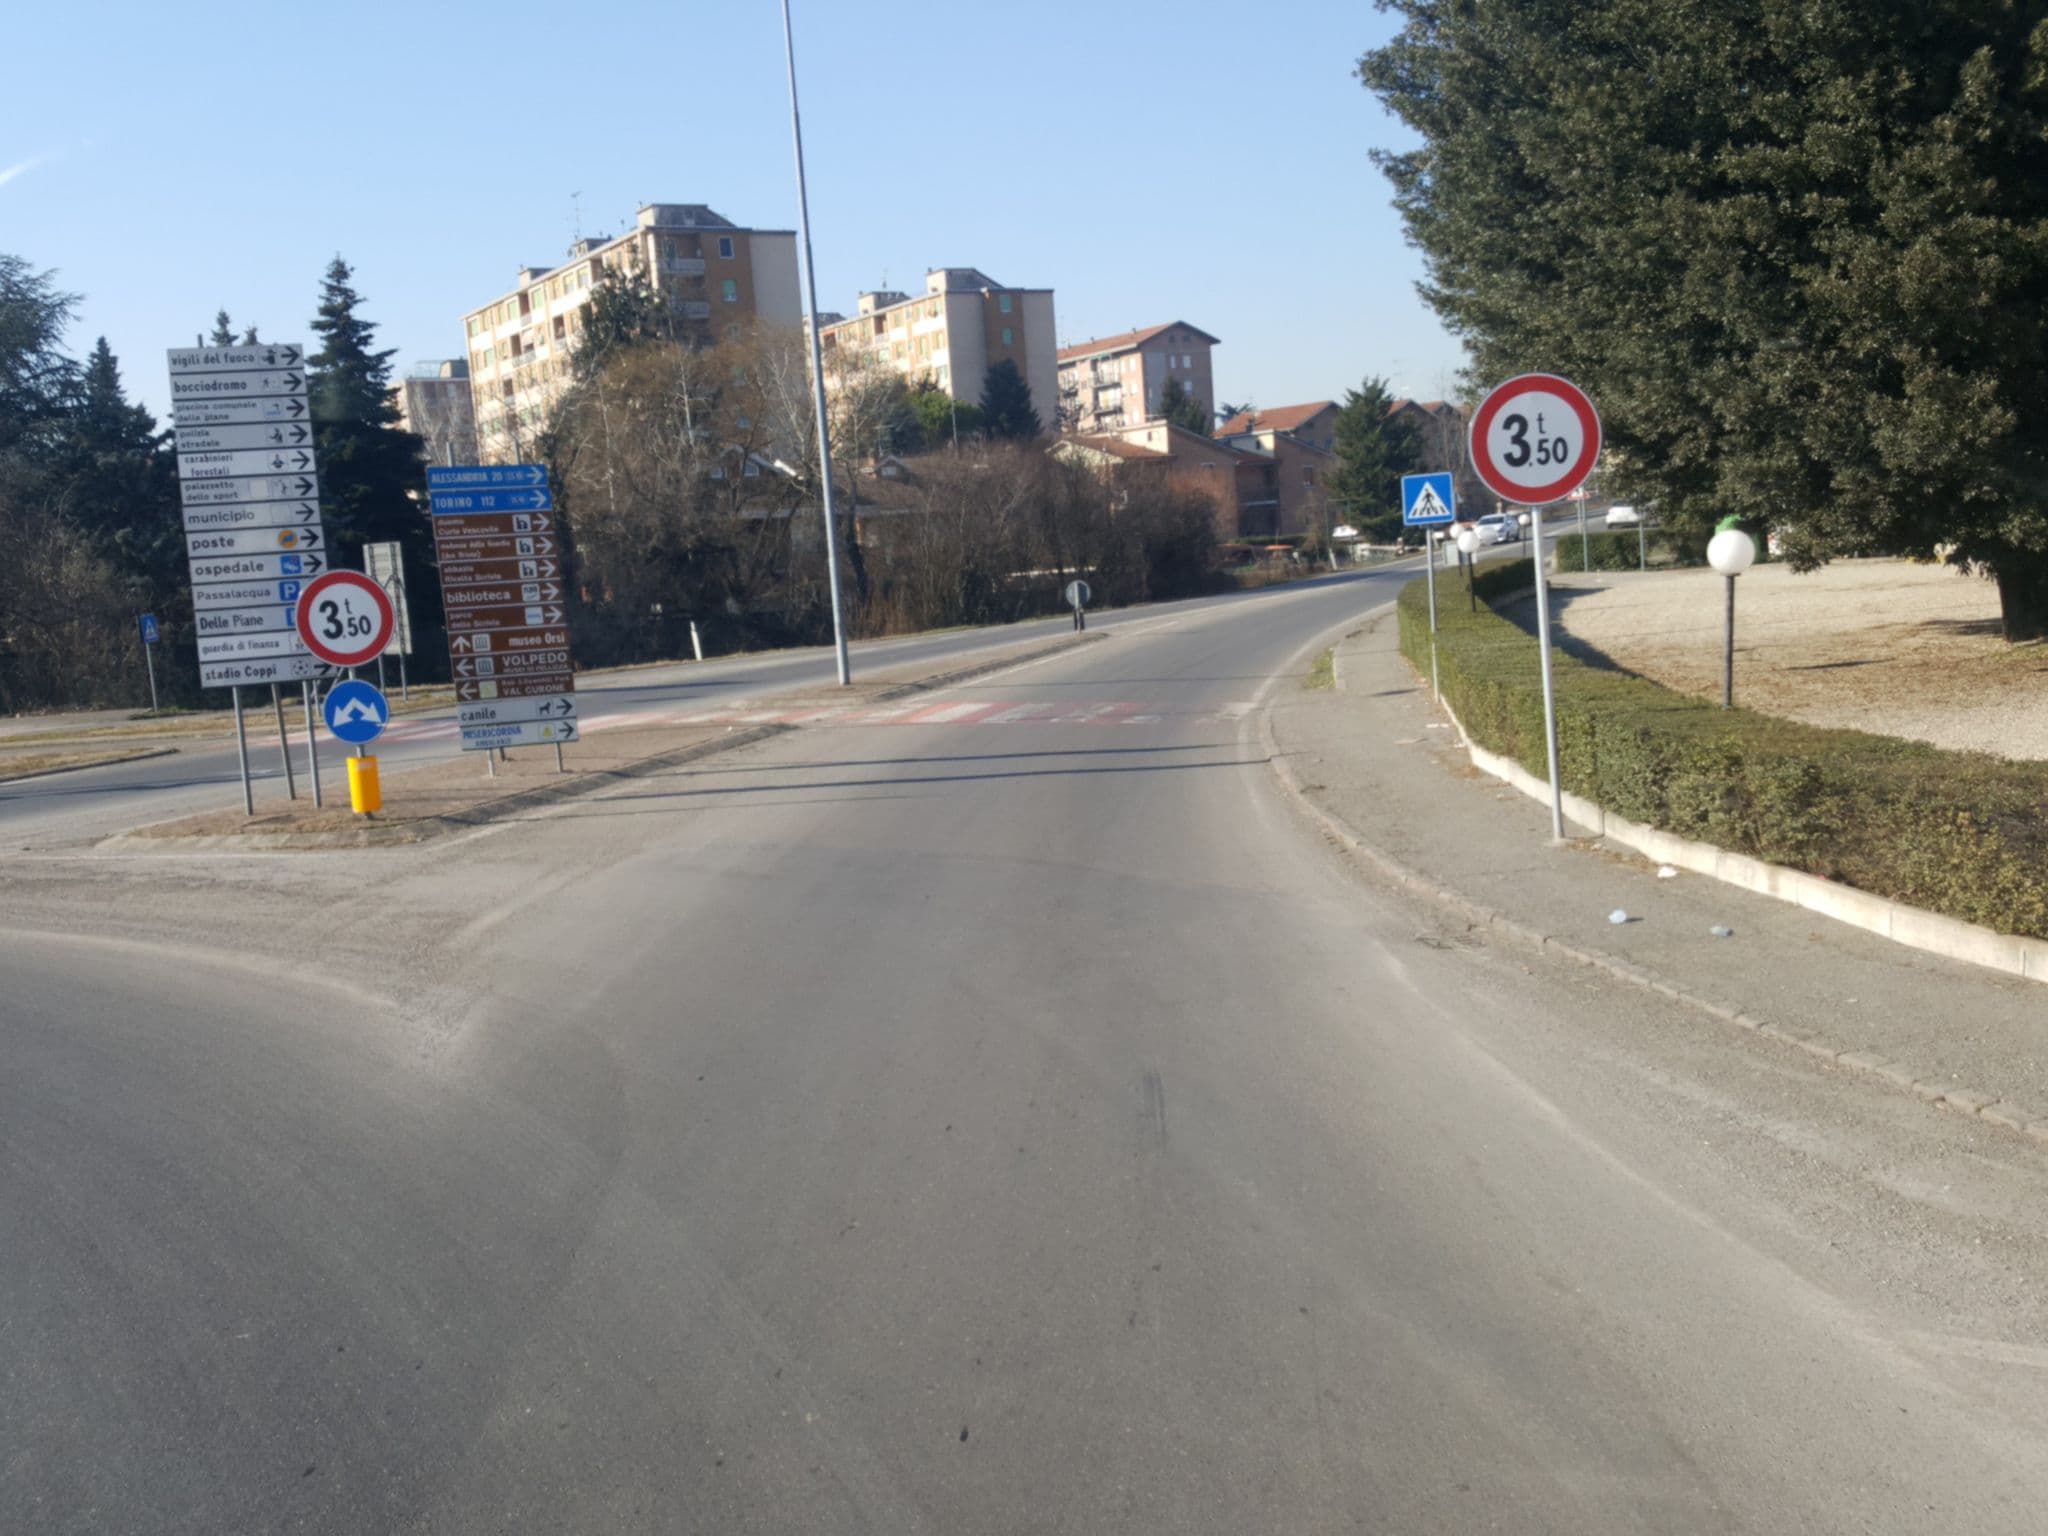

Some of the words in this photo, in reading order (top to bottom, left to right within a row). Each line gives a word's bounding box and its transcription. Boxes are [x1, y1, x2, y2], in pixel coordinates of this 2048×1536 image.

[172, 355, 199, 367] vigili
[204, 353, 220, 364] del
[224, 352, 254, 364] fuoco
[174, 379, 247, 392] bocciodromo
[180, 429, 210, 438] polizia
[181, 439, 220, 448] stradale
[184, 453, 232, 464] carabinieri
[190, 467, 230, 477] forestali
[432, 472, 488, 483] ALESSANDRIA
[185, 481, 234, 491] palazzetto
[186, 492, 210, 501] dello
[214, 490, 238, 500] sport
[435, 496, 472, 508] TORINO
[481, 496, 496, 506] 112
[188, 510, 254, 525] municipio
[192, 536, 235, 550] poste
[195, 560, 264, 576] ospedale
[196, 588, 271, 602] Passalacqua
[284, 584, 296, 598] P
[447, 589, 512, 604] biblioteca
[200, 616, 229, 630] Delle
[234, 615, 264, 628] Piane
[509, 635, 542, 646] museo
[544, 632, 566, 644] Orsi
[202, 642, 235, 655] guardia
[238, 640, 245, 650] di
[248, 638, 280, 650] finanza
[502, 652, 568, 667] VOLPEDO
[206, 668, 241, 680] stadio
[244, 664, 277, 679] Coppi
[503, 686, 522, 697] VAL
[525, 684, 566, 696] CURONE
[461, 708, 496, 720] canile
[463, 726, 522, 739] MISERICORDIA
